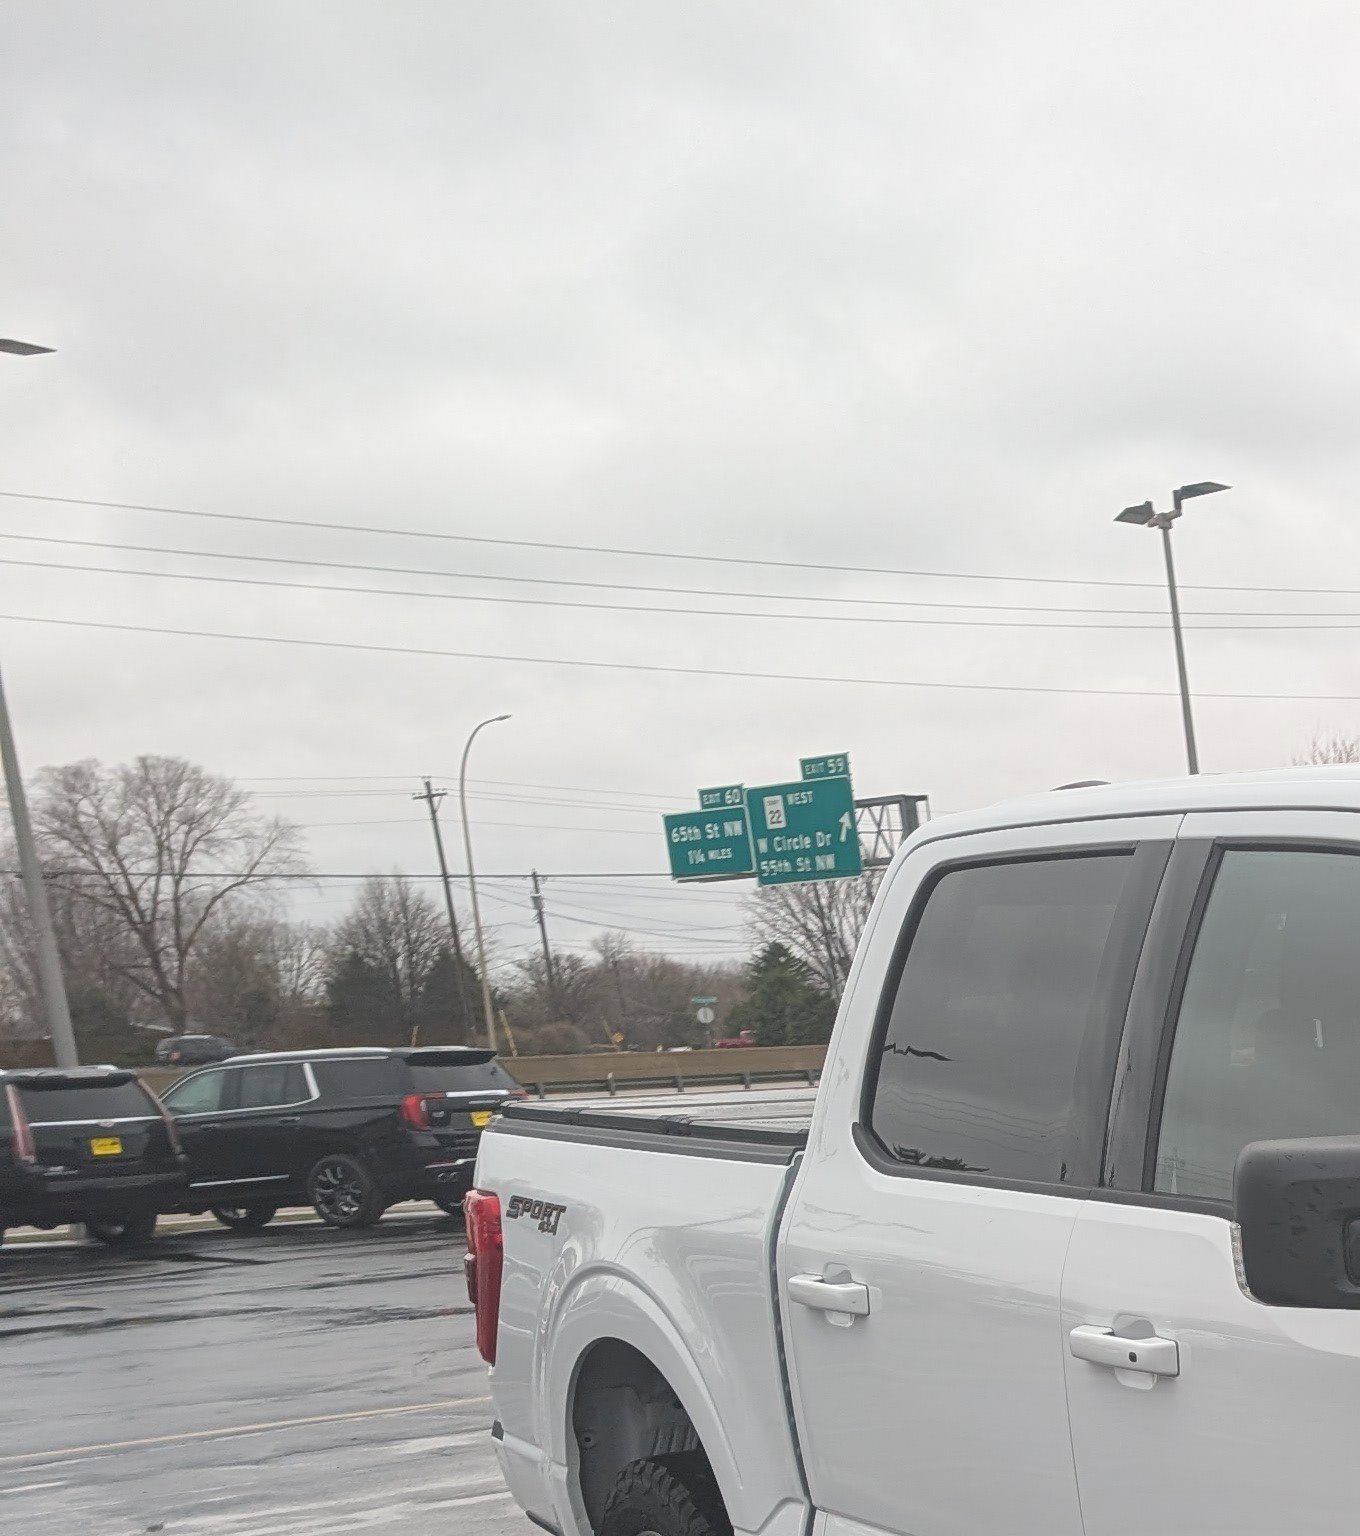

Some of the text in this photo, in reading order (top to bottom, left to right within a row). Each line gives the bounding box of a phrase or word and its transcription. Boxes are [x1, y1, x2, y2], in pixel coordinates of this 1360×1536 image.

[804, 758, 845, 775] EXIT 59
[702, 788, 741, 805] EXIT 60
[786, 791, 813, 805] WEST
[768, 809, 782, 825] 22
[671, 820, 743, 843] 65th St NW
[757, 831, 832, 854] W Circle Dr
[760, 854, 835, 877] 55th St NW
[506, 1195, 567, 1222] SPORT
